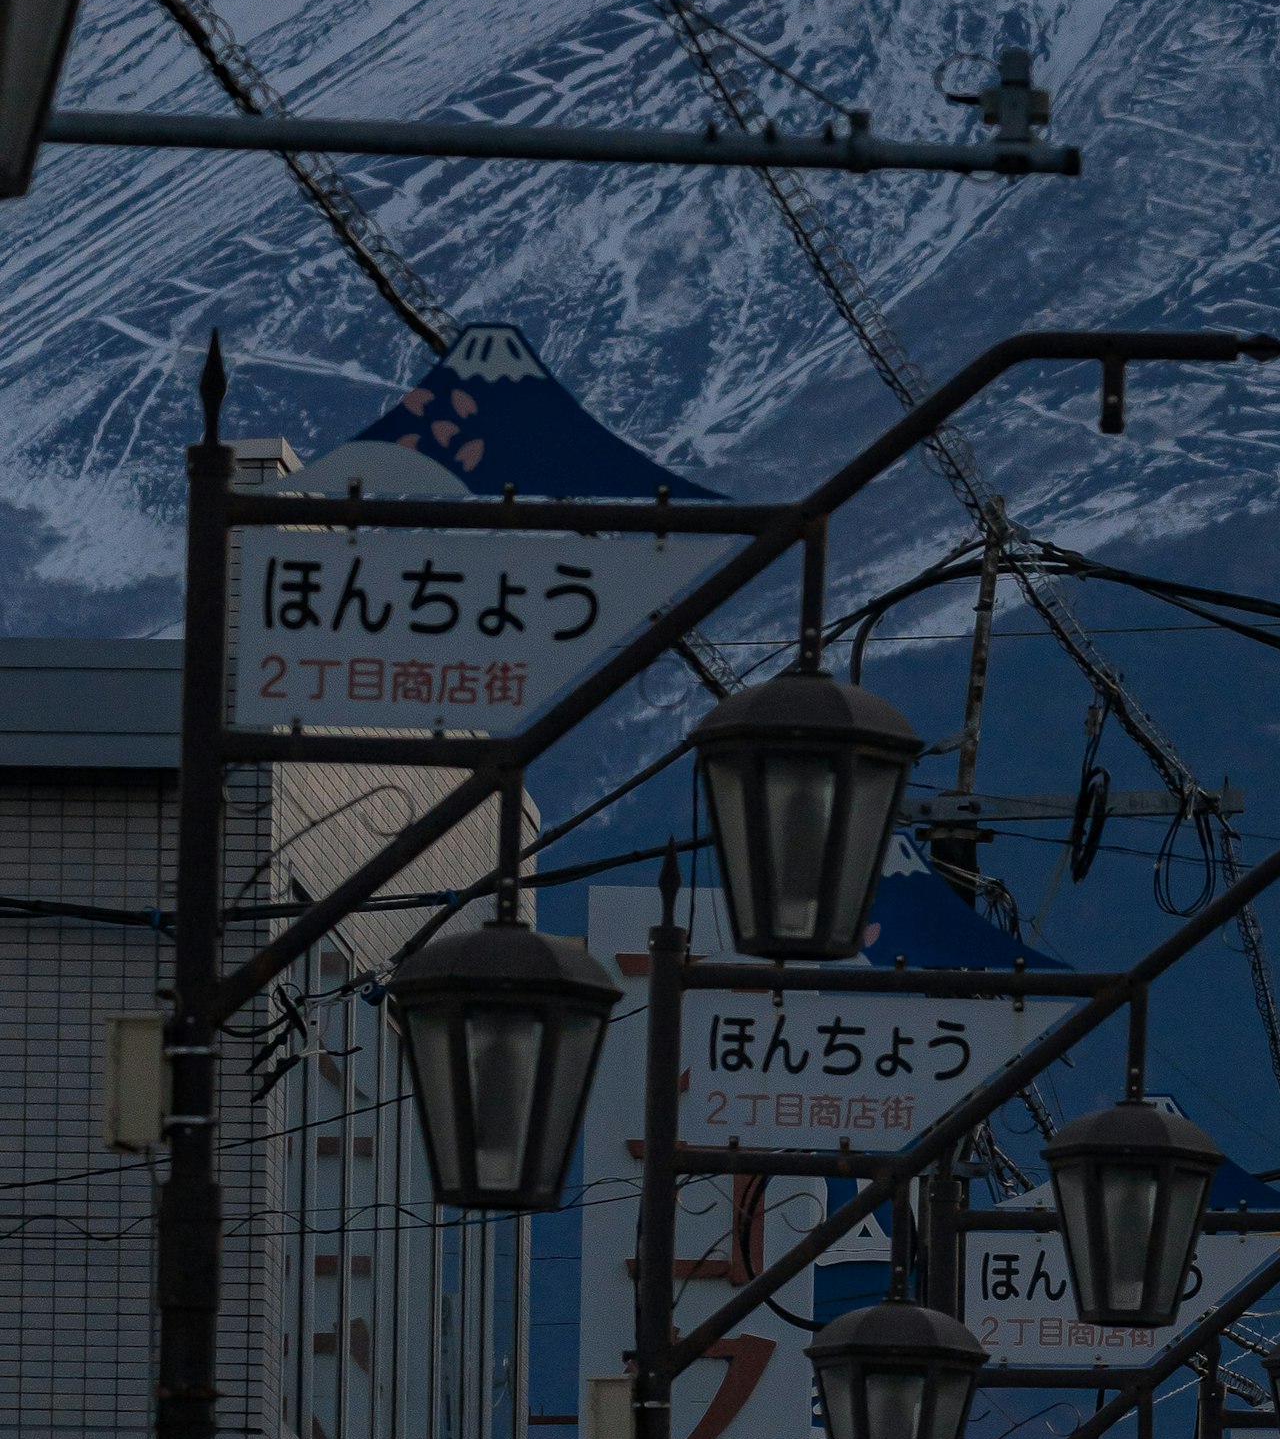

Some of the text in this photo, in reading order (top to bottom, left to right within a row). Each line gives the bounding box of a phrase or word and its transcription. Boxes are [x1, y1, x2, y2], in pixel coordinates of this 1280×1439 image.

[263, 556, 600, 641] ほんちょう
[256, 654, 528, 707] 2丁目商店街
[708, 1014, 973, 1082] ほんちょう
[705, 1090, 915, 1132] 2丁目商店街
